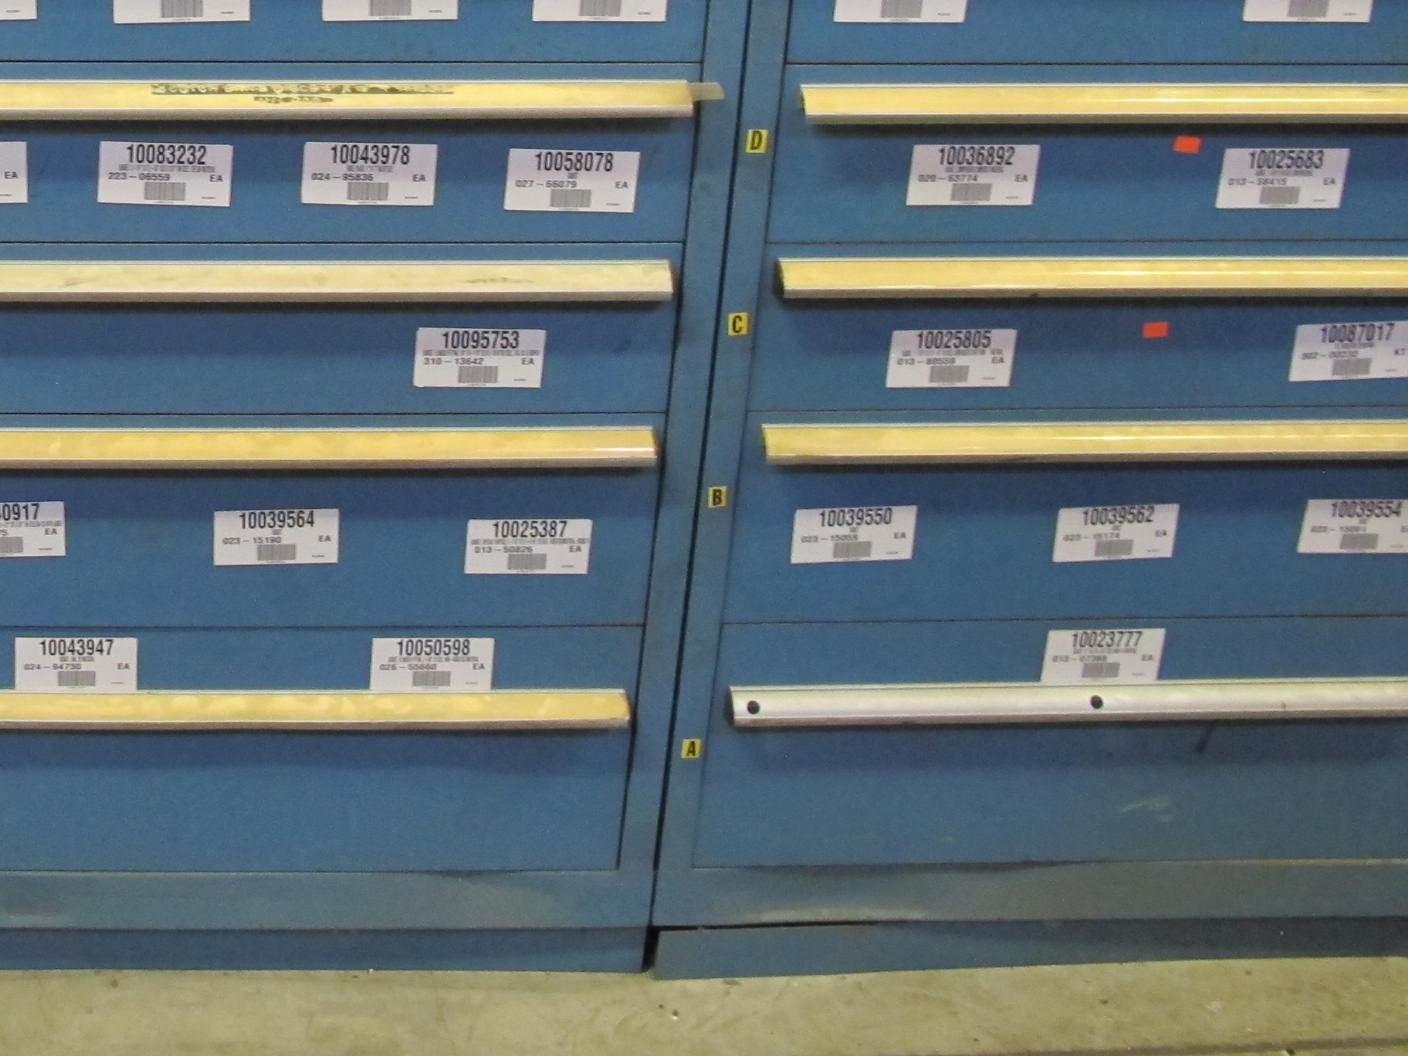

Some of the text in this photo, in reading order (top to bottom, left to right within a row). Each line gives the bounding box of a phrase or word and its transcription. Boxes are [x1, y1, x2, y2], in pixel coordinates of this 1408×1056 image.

[750, 131, 762, 150] D
[127, 145, 206, 164] 10083232
[331, 146, 409, 164] 10043978
[535, 152, 613, 171] 10058078
[939, 147, 1013, 166] 10036892
[1249, 151, 1323, 169] 10025683
[732, 316, 743, 333] C
[443, 331, 519, 349] 10095753
[916, 331, 991, 349] 10025805
[713, 489, 722, 504] B
[239, 511, 314, 528] 10039564
[819, 508, 892, 527] 10039550
[493, 521, 567, 538] 10025387
[40, 640, 113, 656] 10043947
[397, 640, 470, 656] 10050598
[1072, 631, 1142, 647] 10023777
[687, 741, 697, 756] A
